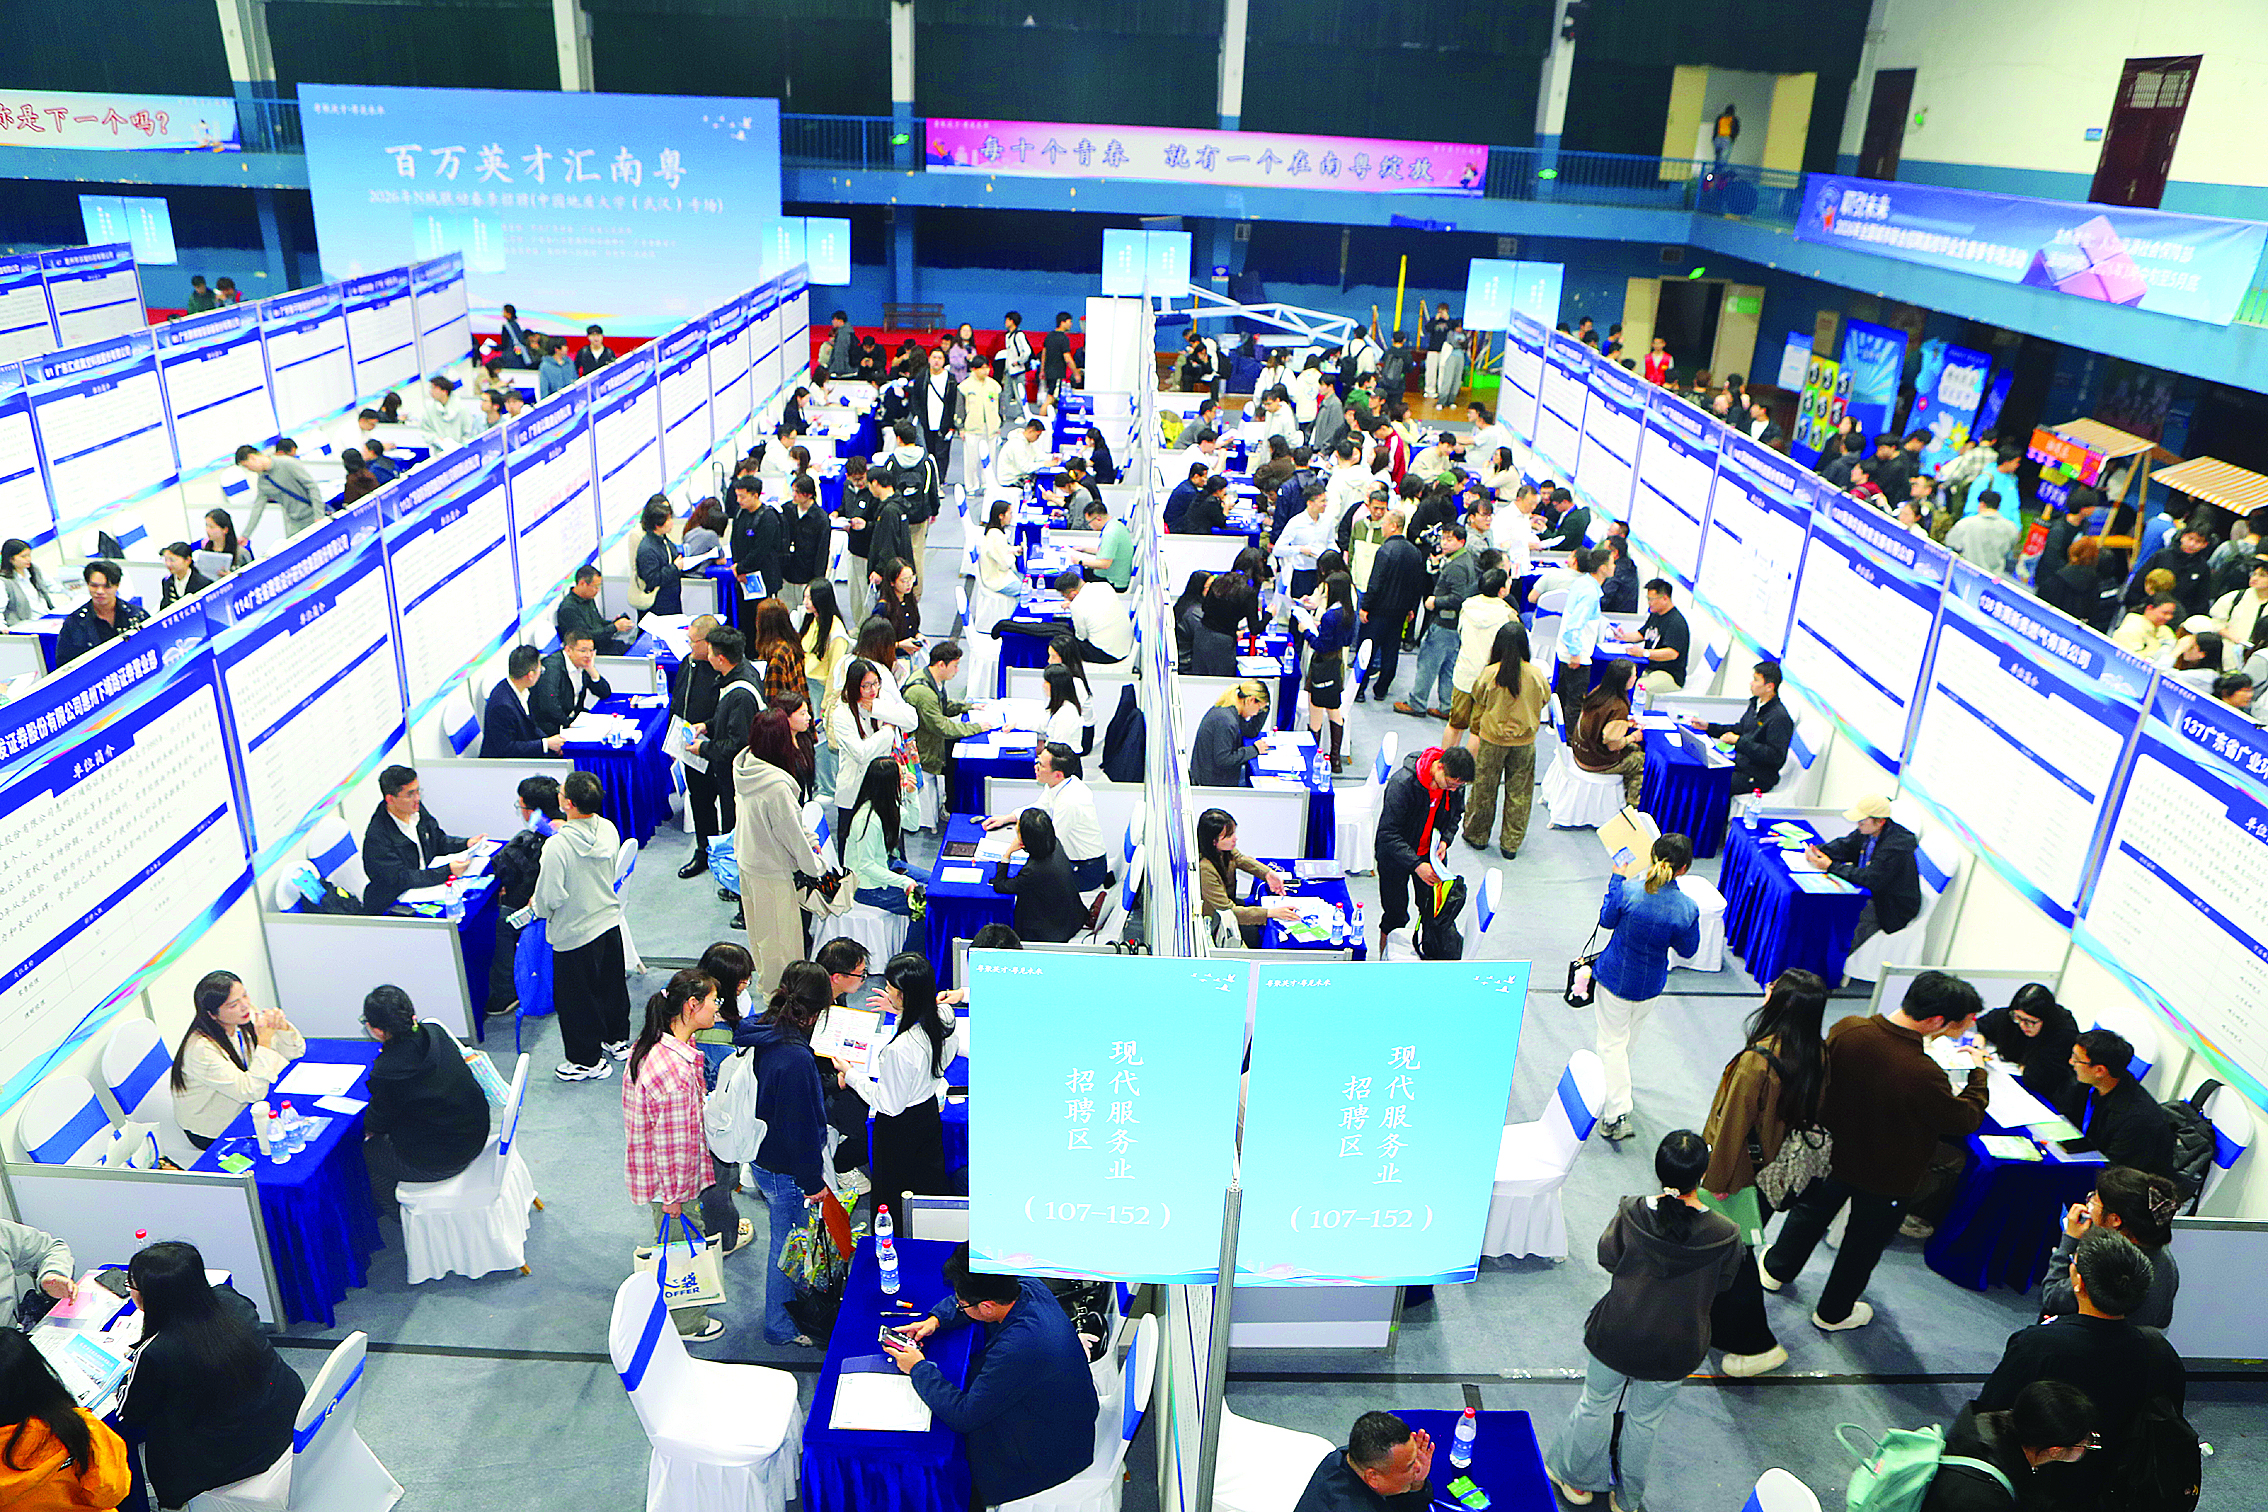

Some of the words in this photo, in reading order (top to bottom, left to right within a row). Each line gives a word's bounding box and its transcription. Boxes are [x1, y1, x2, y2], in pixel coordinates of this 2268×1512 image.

[384, 142, 688, 190] 百万英才汇南粤
[979, 134, 1131, 167] 每十个青春
[1163, 143, 1436, 183] 就有一个在南粤绽放
[72, 744, 116, 779] 单位简介
[2245, 817, 2268, 843] 单位
[1065, 1068, 1096, 1151] 招聘区
[1104, 1039, 1144, 1180] 现代服务业
[1338, 1075, 1373, 1158] 招聘区
[1373, 1045, 1421, 1186] 现代服务业
[665, 1286, 701, 1298] OFFER
